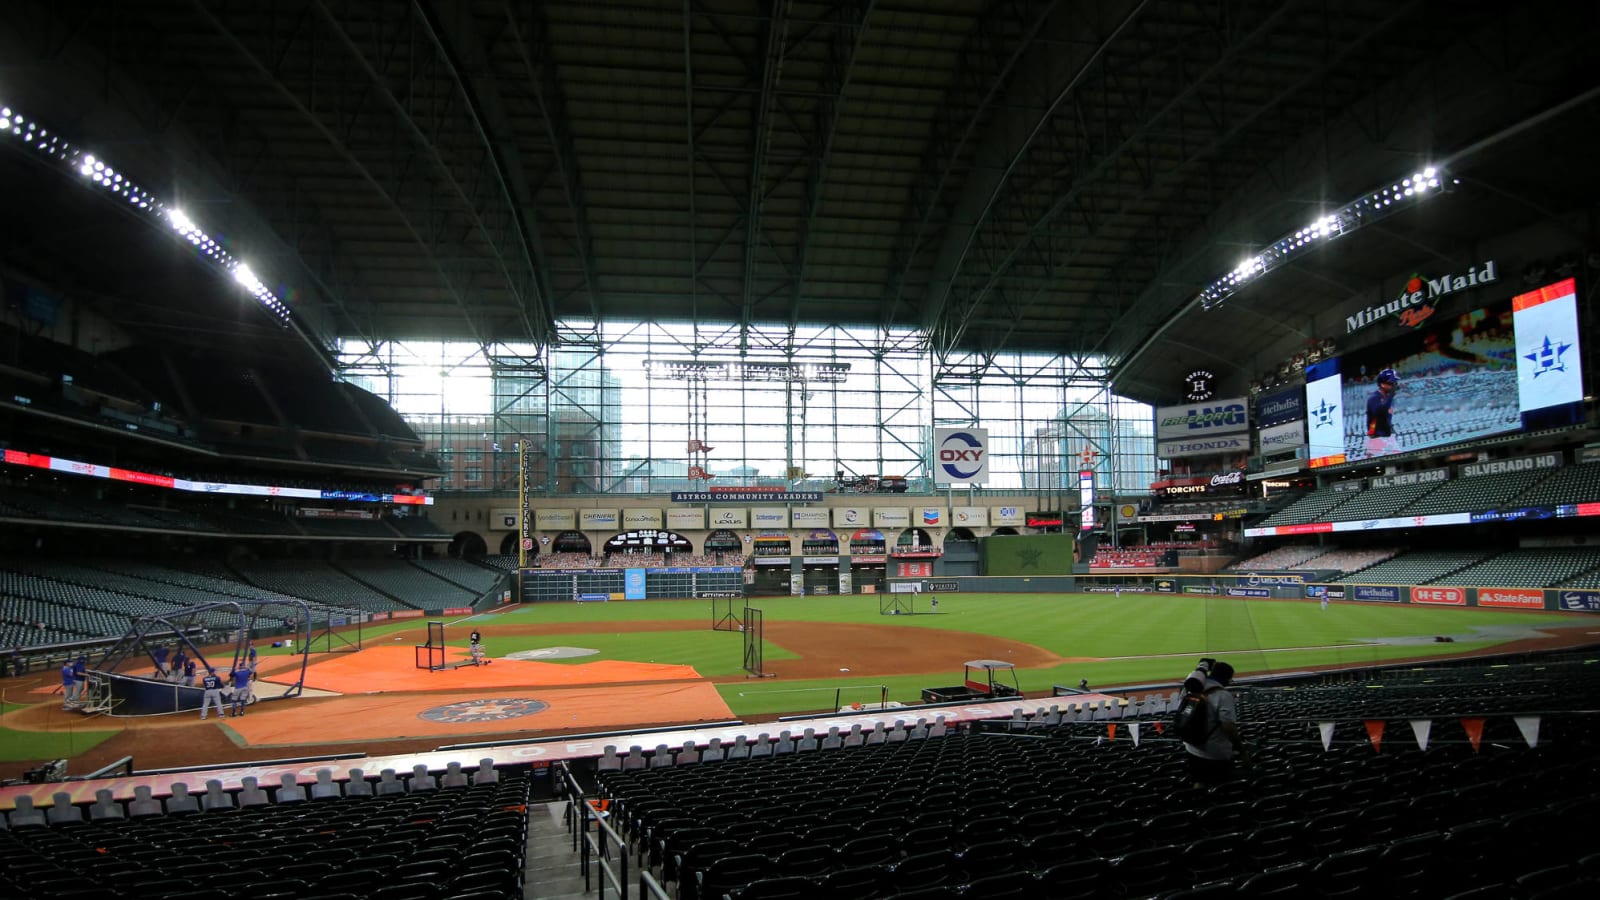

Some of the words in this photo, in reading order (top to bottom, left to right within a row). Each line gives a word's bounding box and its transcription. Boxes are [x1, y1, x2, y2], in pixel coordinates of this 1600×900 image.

[1346, 289, 1423, 334] Minute
[1428, 260, 1496, 298] Maid
[1193, 380, 1206, 392] H
[1263, 398, 1299, 415] Methodist
[1160, 411, 1234, 426] FREEPORT
[1188, 404, 1245, 429] LNG
[1179, 439, 1241, 452] HONDA
[940, 450, 983, 461] OXY
[1465, 458, 1533, 476] SILVERADO
[1536, 455, 1555, 468] HD
[1210, 472, 1242, 486] Coca-Cola
[1373, 474, 1417, 488] ALL-NEW
[1420, 470, 1445, 482] 2020
[1166, 485, 1206, 494] TORCHYS
[1358, 587, 1394, 598] Methodist
[1494, 593, 1516, 602] State
[1517, 595, 1542, 604] Farm
